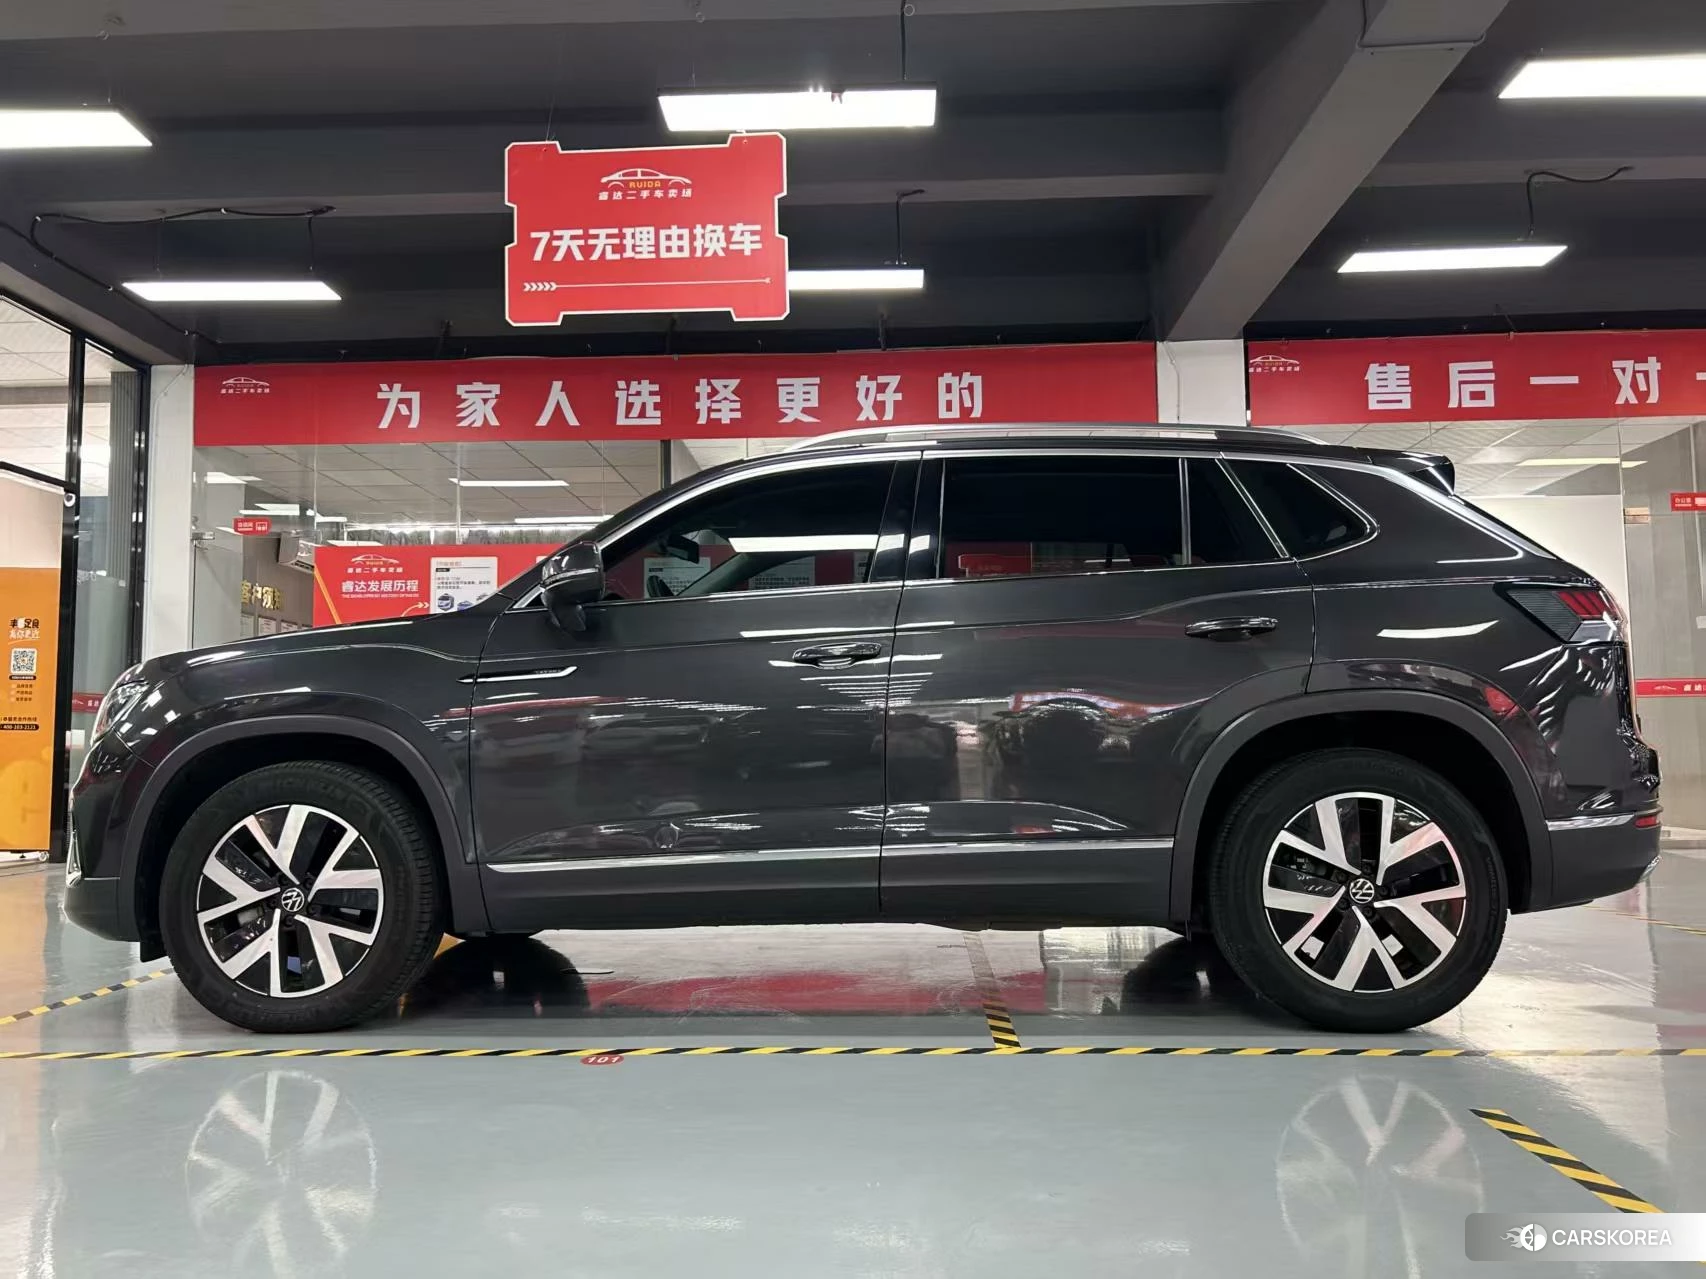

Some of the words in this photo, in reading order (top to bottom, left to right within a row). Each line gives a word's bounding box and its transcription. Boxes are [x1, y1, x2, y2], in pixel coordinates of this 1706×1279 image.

[598, 188, 692, 201] 睿达二手车卖场
[530, 224, 762, 262] 7天无理由换车
[376, 372, 984, 429] 为家人选择更好的
[1364, 355, 1706, 410] 售后一对
[342, 579, 419, 592] 睿达发展历程
